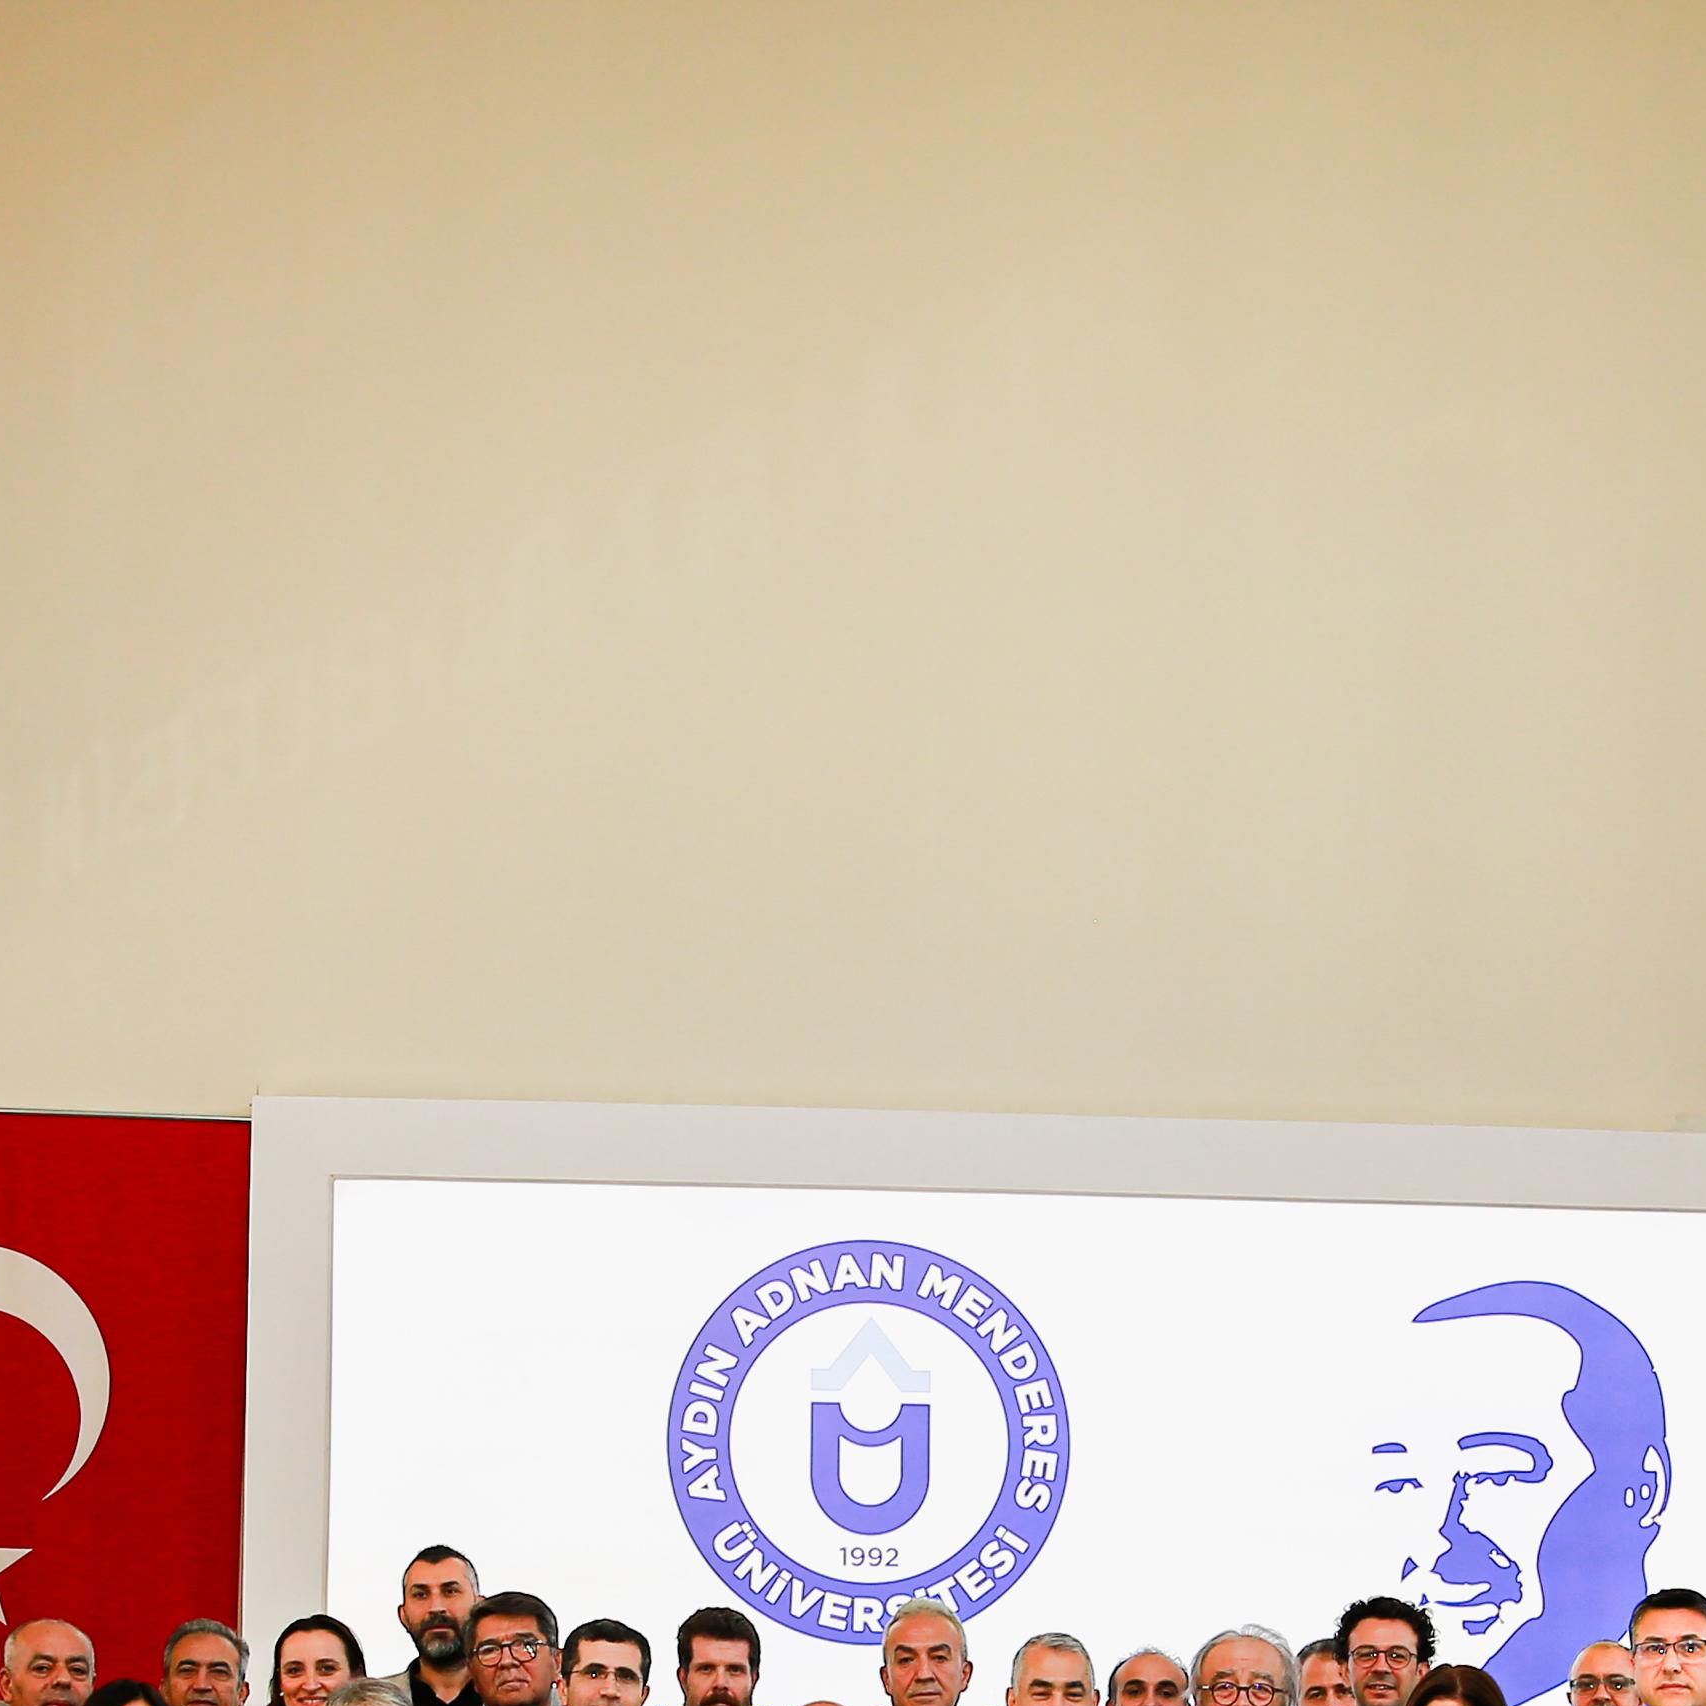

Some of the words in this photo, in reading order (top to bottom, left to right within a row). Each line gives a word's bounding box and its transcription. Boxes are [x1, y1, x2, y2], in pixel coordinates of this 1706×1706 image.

[680, 1343, 739, 1503] AYDIN
[730, 1252, 906, 1348] ADNAN
[917, 1263, 1060, 1513] MENDERES
[838, 1546, 900, 1568] 1992
